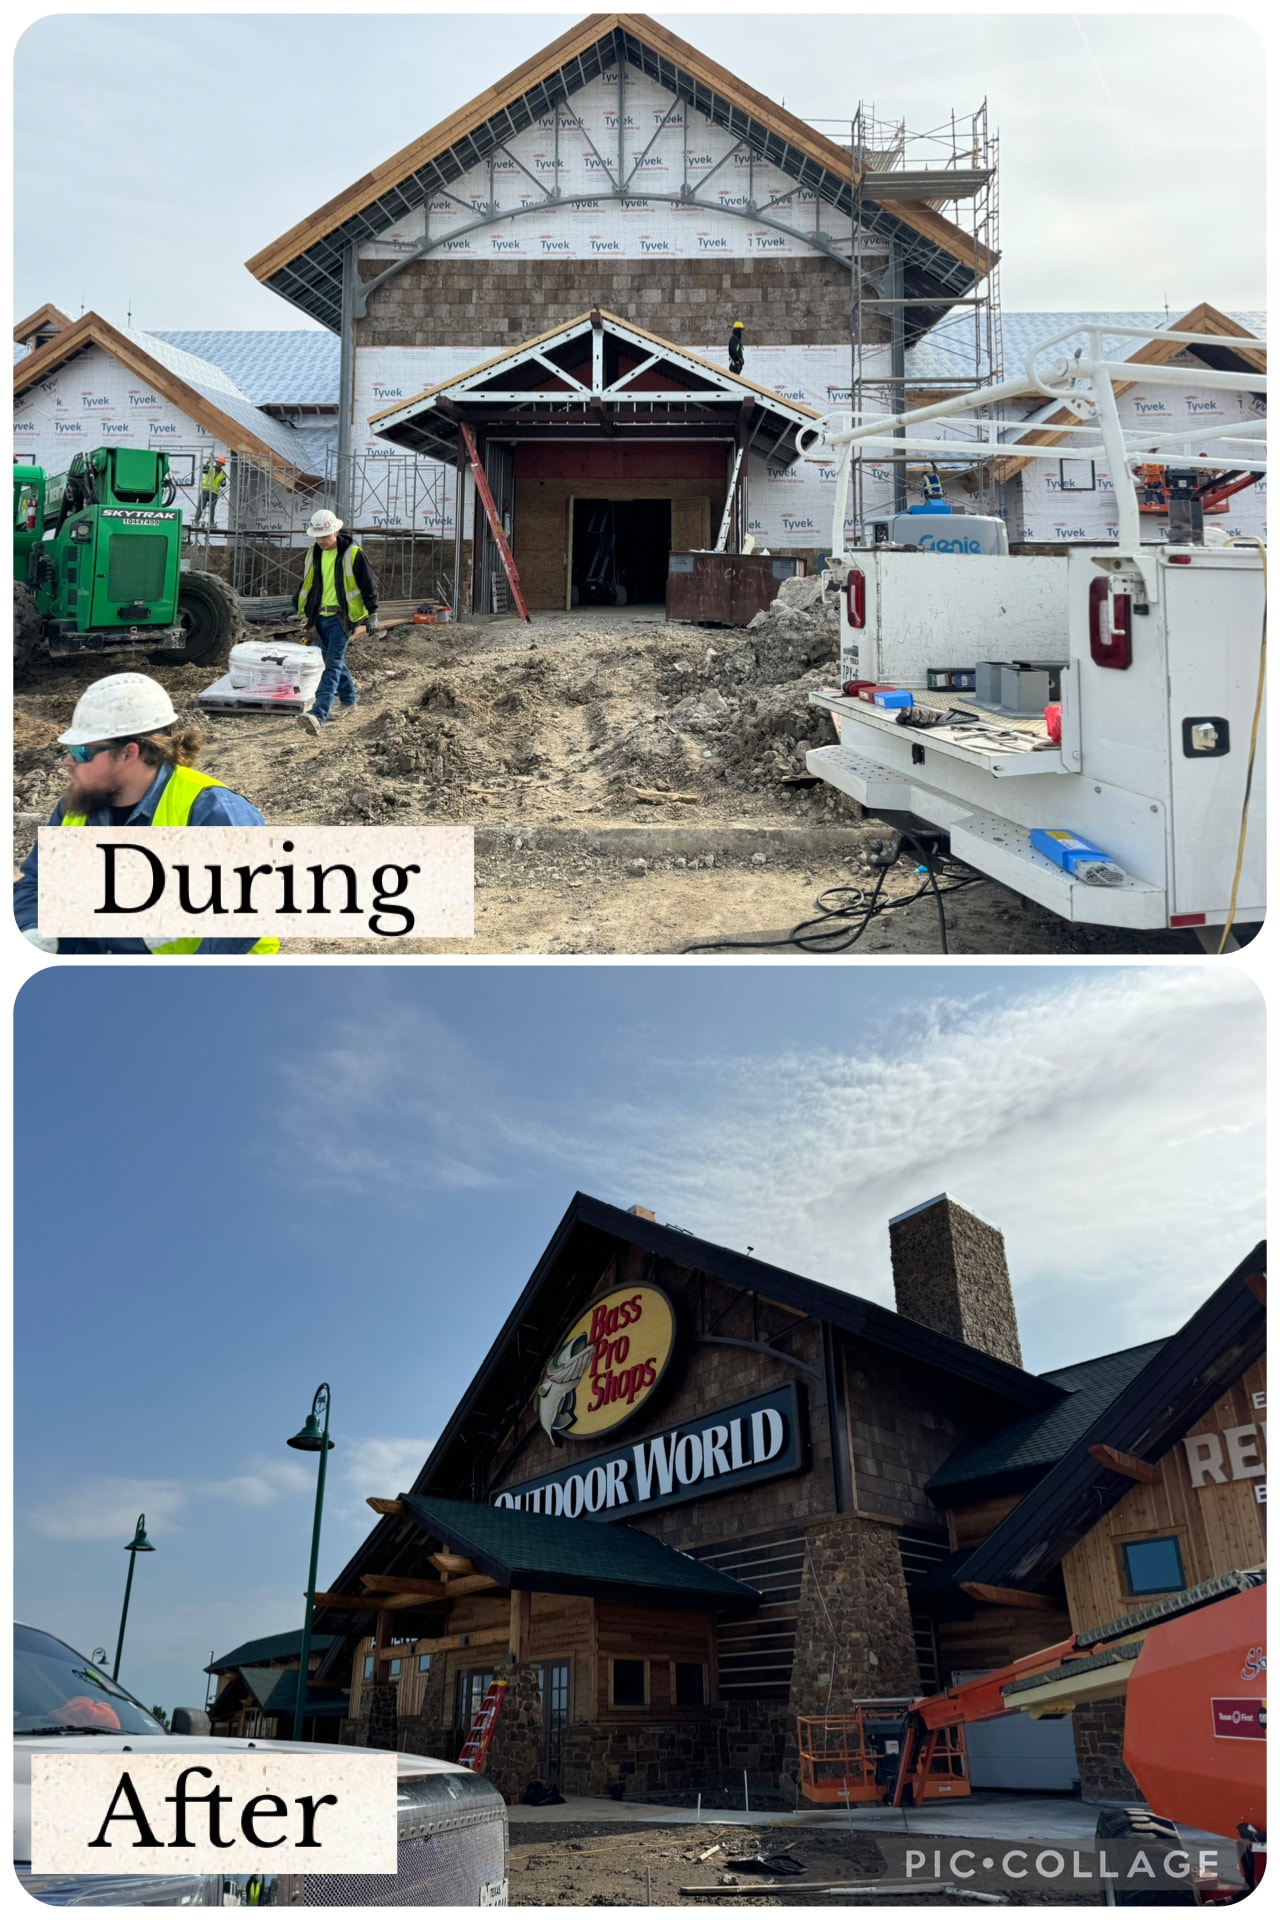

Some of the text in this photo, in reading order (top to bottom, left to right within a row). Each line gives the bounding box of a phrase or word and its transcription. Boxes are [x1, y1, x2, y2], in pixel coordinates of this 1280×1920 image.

[571, 200, 598, 210] Tyvek
[620, 199, 648, 209] Tyvek
[719, 196, 748, 206] Tyvek
[443, 240, 470, 250] Tyvek
[492, 240, 520, 250] Tyvek
[541, 240, 569, 250] Tyvek
[590, 240, 618, 251] Tyvek
[640, 240, 668, 252] Tyvek
[698, 238, 726, 248] Tyvek
[756, 238, 785, 248] Tyvek
[372, 388, 402, 398] Tyvek
[82, 396, 109, 407] Tyvek
[129, 395, 156, 405] Tyvek
[1134, 402, 1165, 413] Tyvek
[1186, 401, 1216, 412] Tyvek
[54, 422, 82, 432] Tyvek
[101, 422, 128, 433] Tyvek
[149, 424, 176, 434] Tyvek
[767, 467, 796, 478] Tyvek
[102, 509, 176, 519] SKYTRAK
[372, 516, 402, 527] Tyvek
[423, 516, 452, 527] Tyvek
[782, 518, 813, 530] Tyvek
[1056, 528, 1086, 538] Tyvek
[919, 534, 982, 554] Genie
[588, 1294, 642, 1345] Bass
[589, 1335, 630, 1379] Pro
[587, 1357, 657, 1413] Shops
[632, 1408, 784, 1502] WORLD
[1182, 1421, 1267, 1488] RE
[1219, 1712, 1232, 1721] Texas
[1241, 1712, 1253, 1722] First
